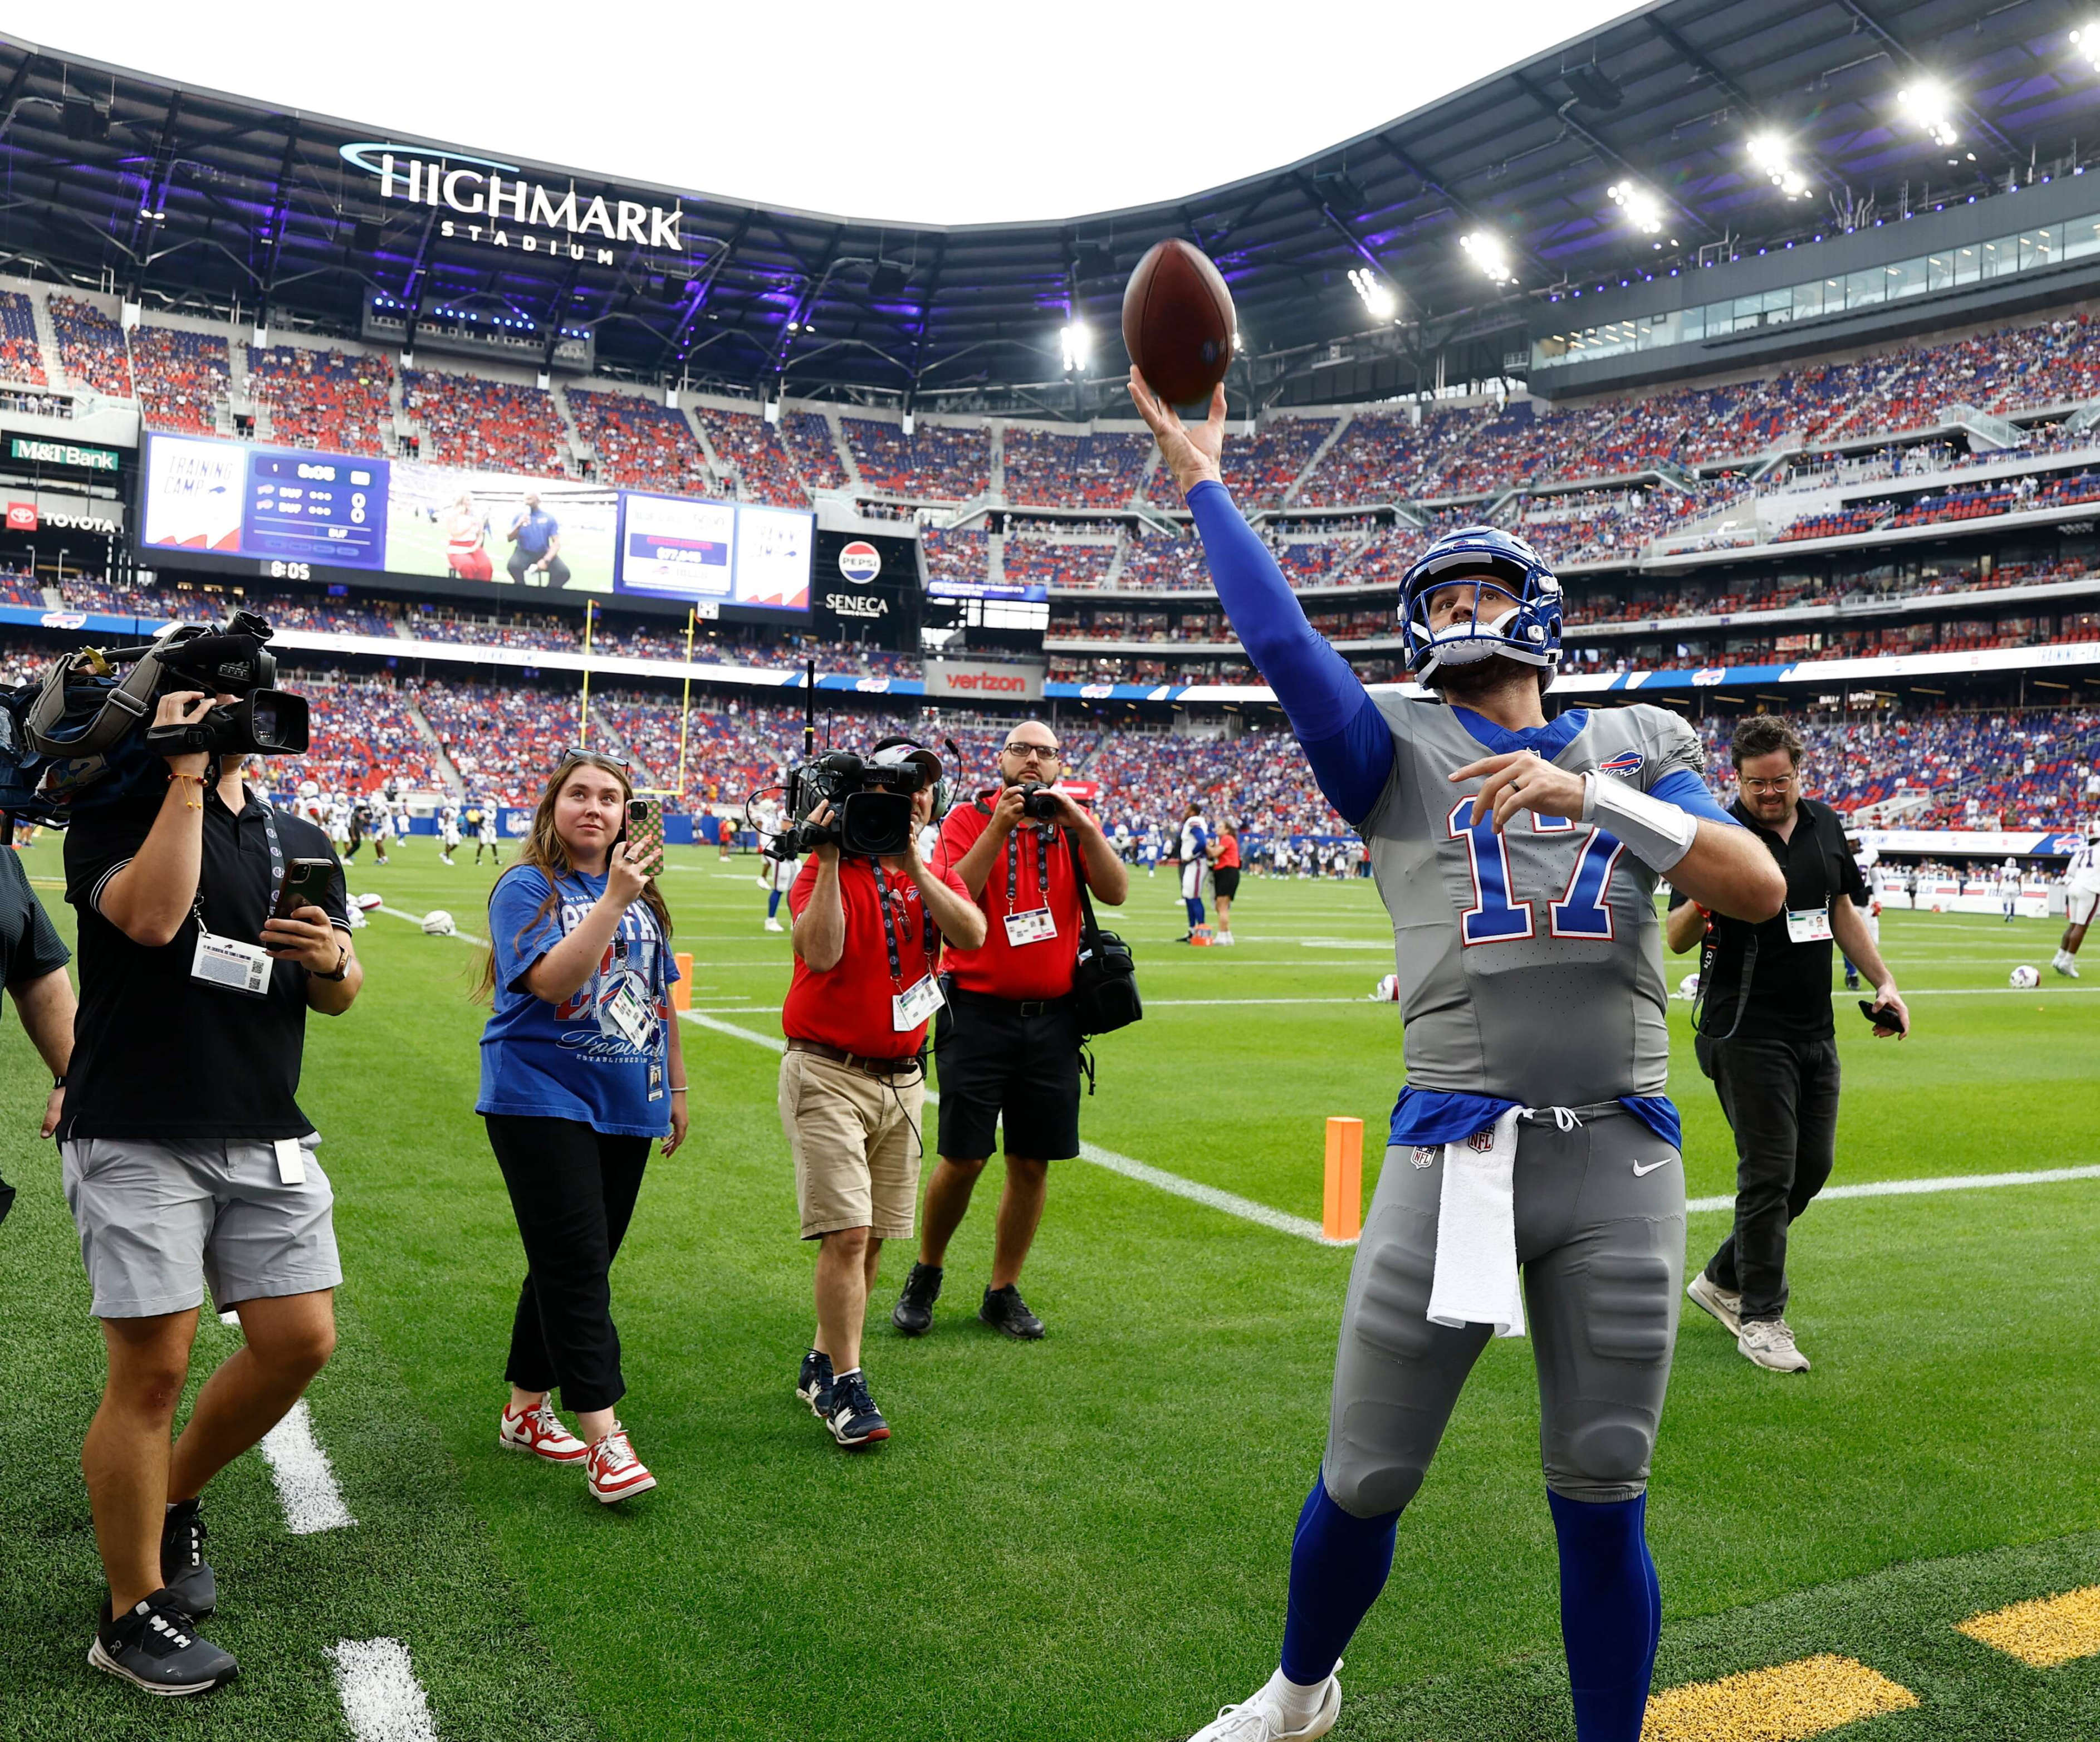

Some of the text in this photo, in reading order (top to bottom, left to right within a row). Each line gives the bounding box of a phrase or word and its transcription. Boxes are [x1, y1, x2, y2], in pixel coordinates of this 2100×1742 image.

[380, 154, 683, 251] HIGHMARK
[441, 221, 613, 265] STADIUM
[65, 447, 114, 469] Bank
[169, 454, 234, 480] TRAINING
[164, 476, 204, 498] CAMP
[44, 512, 116, 534] TOYOTA
[271, 561, 310, 580] 8:05
[843, 557, 877, 566] PEPSI
[825, 593, 889, 614] SENECA
[947, 672, 1026, 692] verizon
[2078, 849, 2094, 868] 71
[1447, 794, 1624, 947] 17
[576, 1054, 638, 1063] ESTABLISHED
[1470, 1132, 1491, 1149] NFL
[1414, 1151, 1430, 1164] NFL
